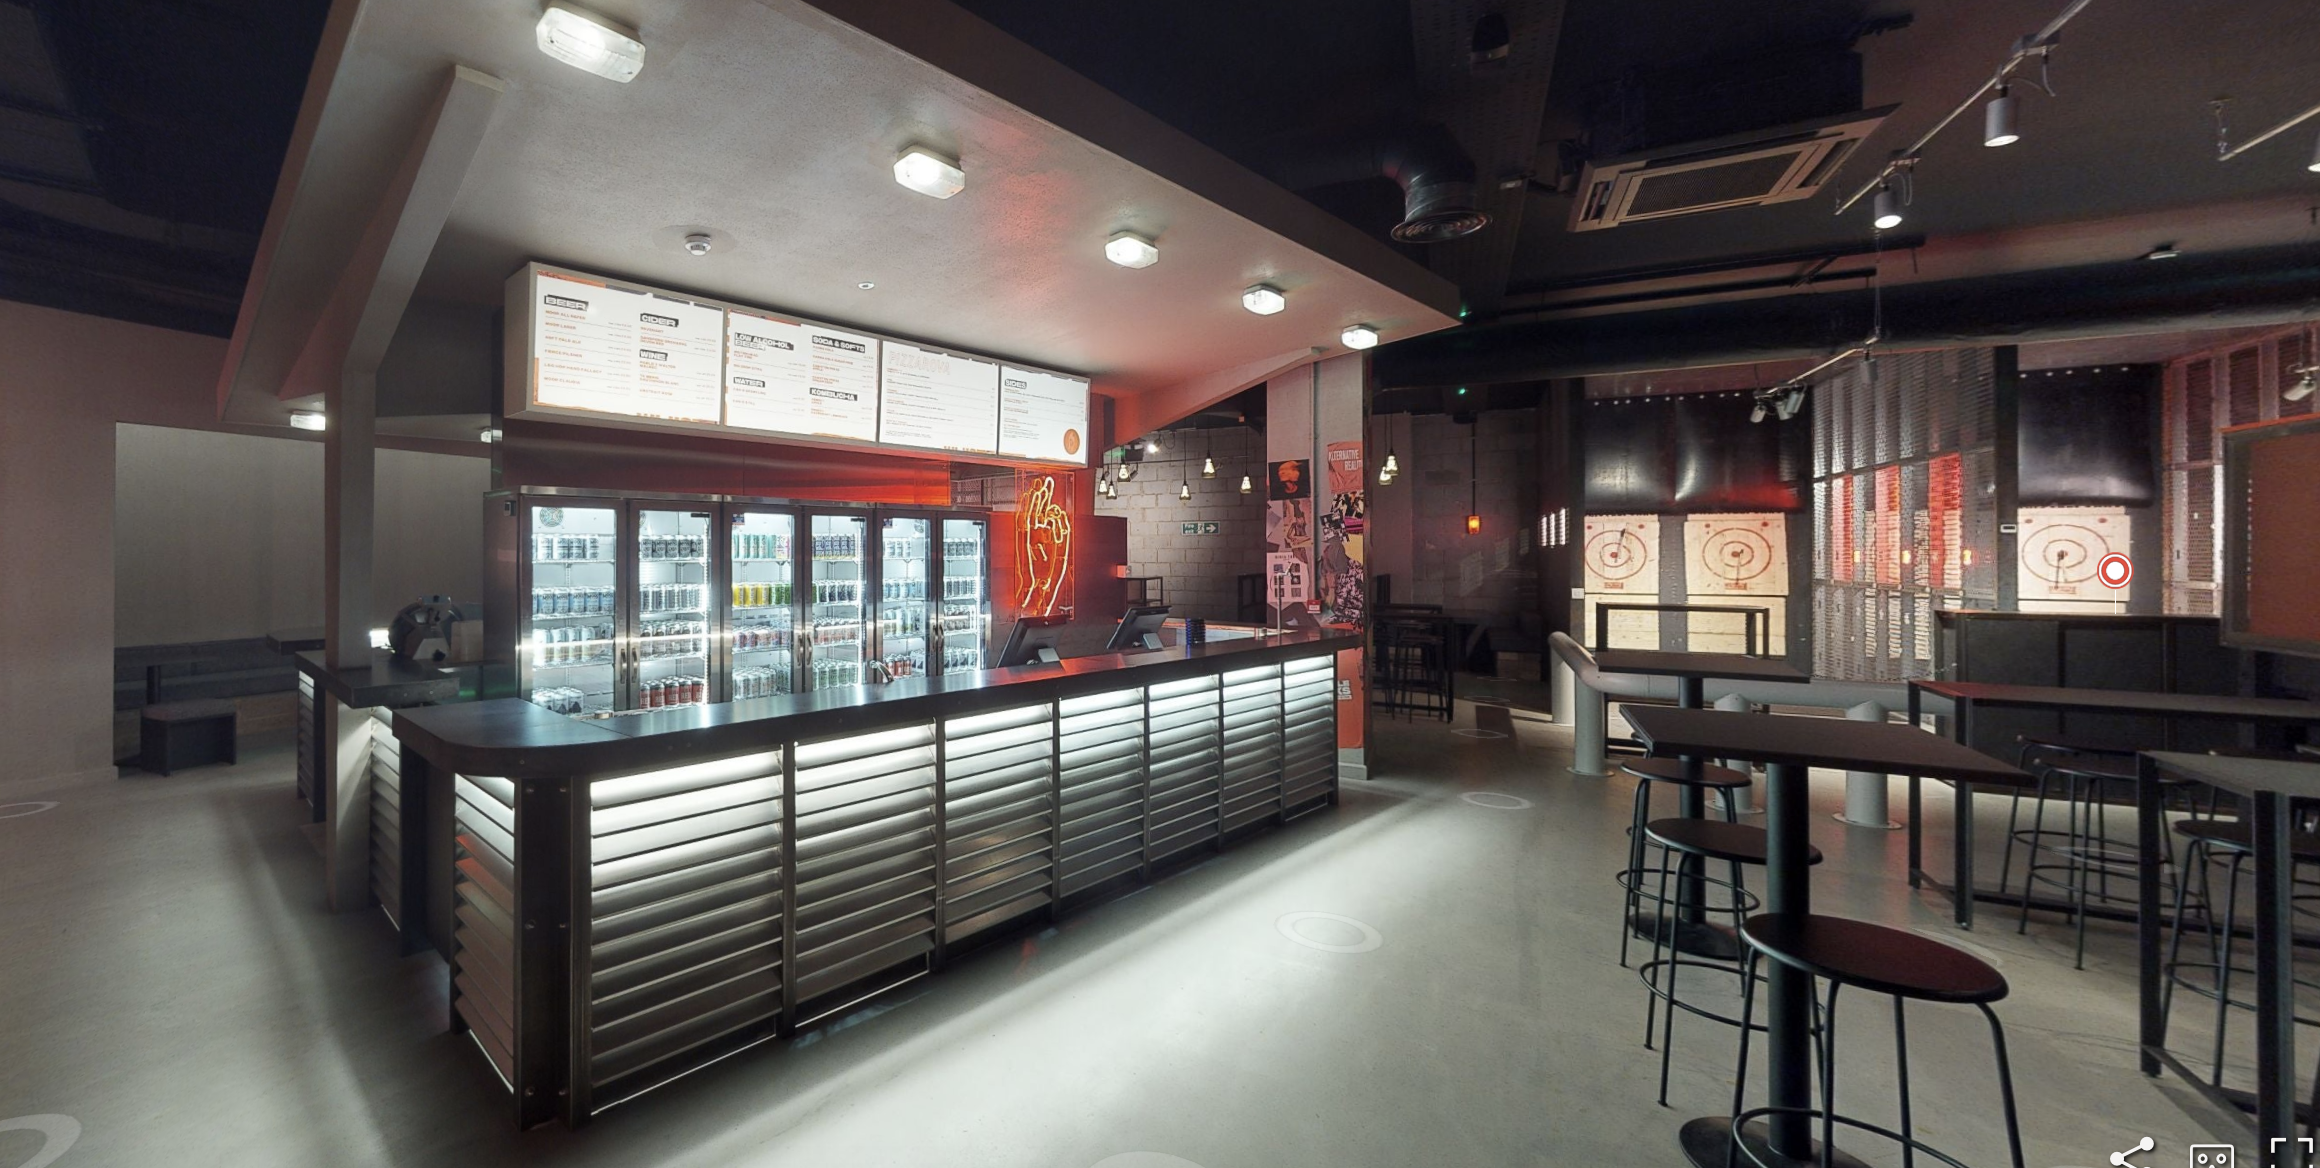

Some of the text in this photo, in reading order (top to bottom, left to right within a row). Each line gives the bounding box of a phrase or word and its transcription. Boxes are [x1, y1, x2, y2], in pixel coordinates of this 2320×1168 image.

[545, 296, 587, 311] BEER
[641, 314, 677, 327] CIDER
[735, 333, 790, 349] LOW ALCOHOL
[813, 336, 834, 346] SODA
[840, 342, 865, 353] SOFTS
[640, 351, 667, 361] WINE
[735, 377, 763, 388] WATER
[1005, 379, 1026, 389] SIDES
[811, 389, 855, 401] KOMBUCHA
